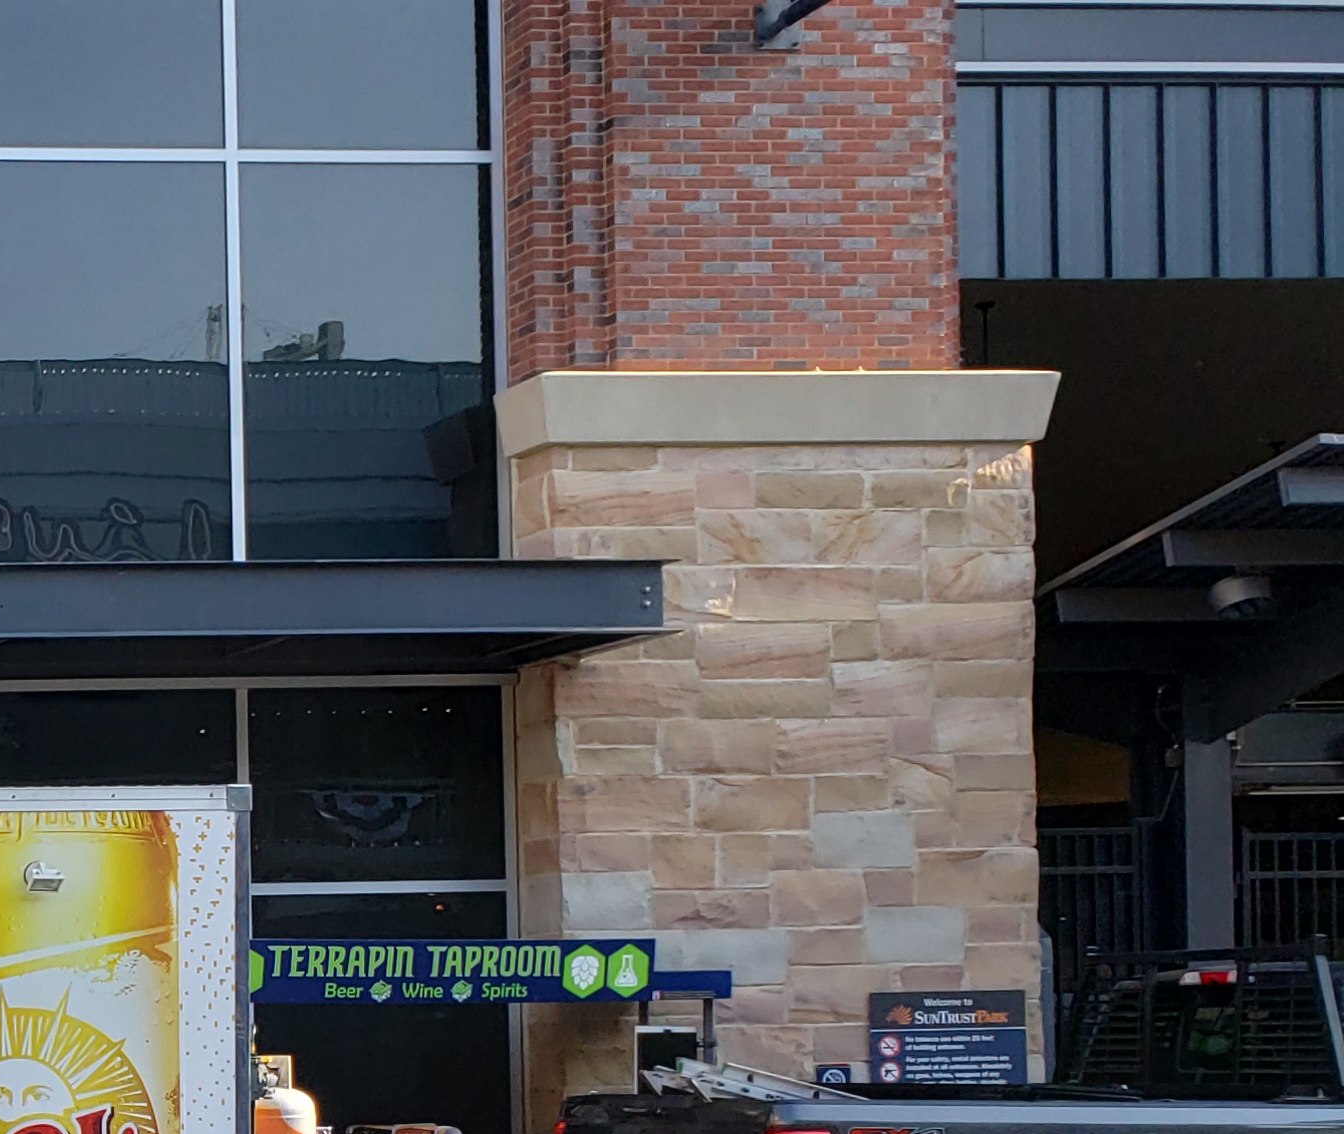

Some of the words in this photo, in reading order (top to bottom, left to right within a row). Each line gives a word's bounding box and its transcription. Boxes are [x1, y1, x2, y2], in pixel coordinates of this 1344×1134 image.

[267, 945, 414, 978] TERRAPIN
[426, 945, 562, 978] TAPROOM
[324, 982, 364, 998] Beer
[402, 982, 443, 998] Wine
[481, 981, 528, 1001] Spirits
[923, 998, 962, 1007] Welcome
[964, 998, 974, 1007] to
